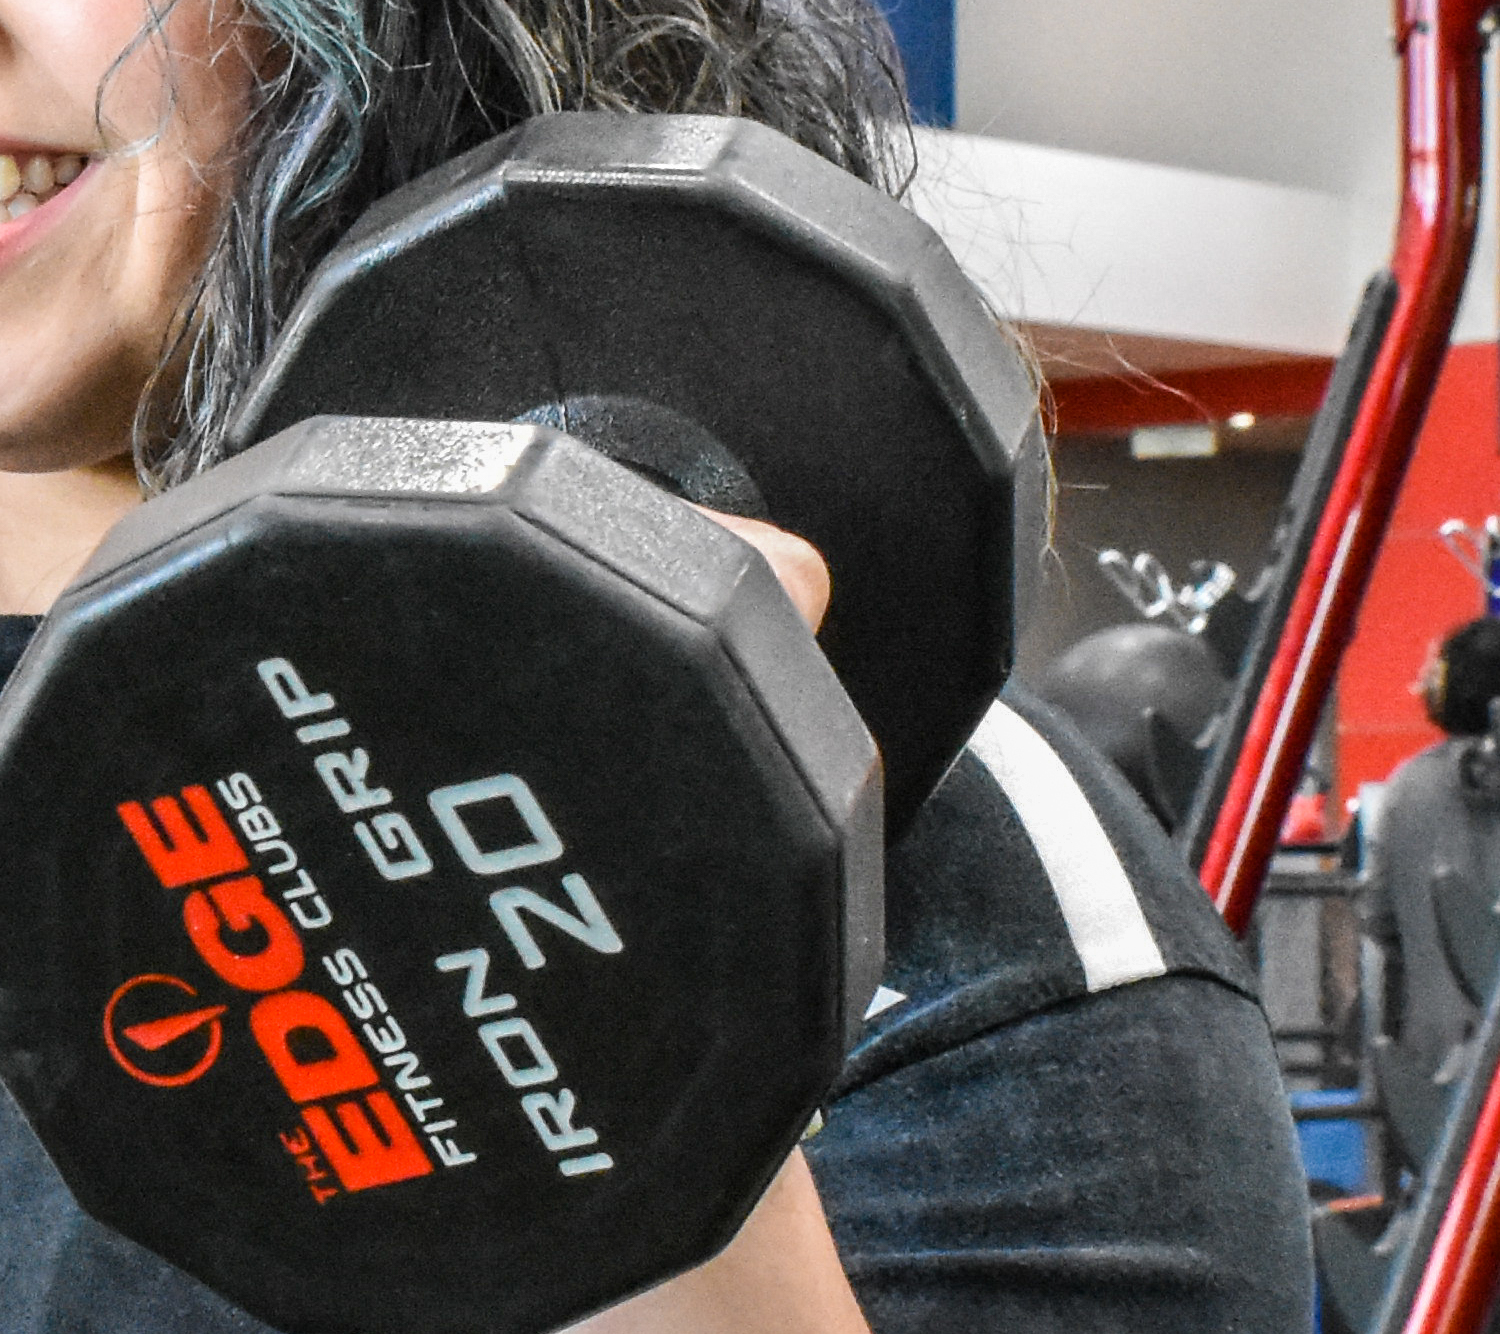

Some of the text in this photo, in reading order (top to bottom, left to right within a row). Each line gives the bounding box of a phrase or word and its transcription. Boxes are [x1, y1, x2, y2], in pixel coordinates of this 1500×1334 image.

[115, 783, 434, 1193] EDGE
[214, 770, 478, 1168] FITNESS CLUBS
[256, 656, 615, 1177] IRON GRIP
[427, 771, 625, 971] 20
[279, 1125, 340, 1206] THE
